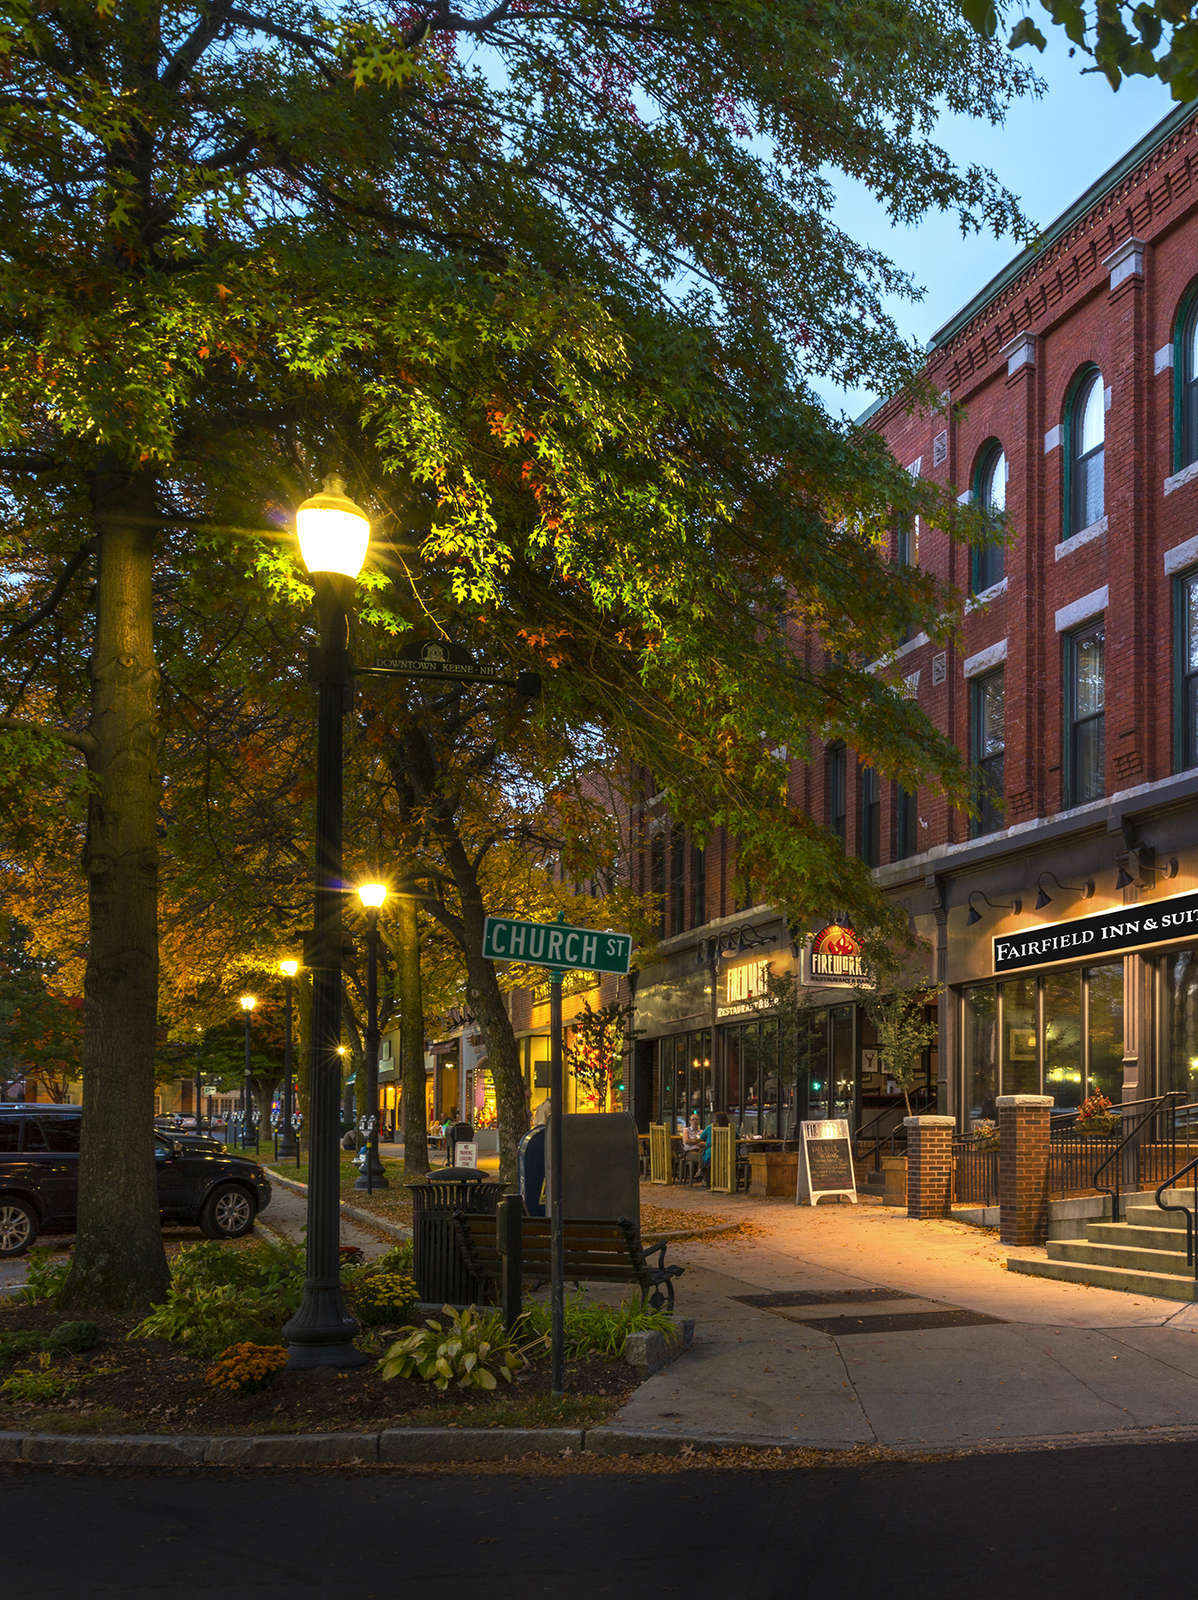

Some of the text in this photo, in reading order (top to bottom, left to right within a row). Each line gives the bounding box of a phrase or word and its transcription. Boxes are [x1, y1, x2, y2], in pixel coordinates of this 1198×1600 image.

[376, 659, 494, 675] DOWNTOWN KEENE NH
[492, 923, 597, 965] CHURCH
[996, 930, 1094, 961] FAIRFIELD
[1101, 921, 1140, 940] INN
[1143, 918, 1158, 931] &
